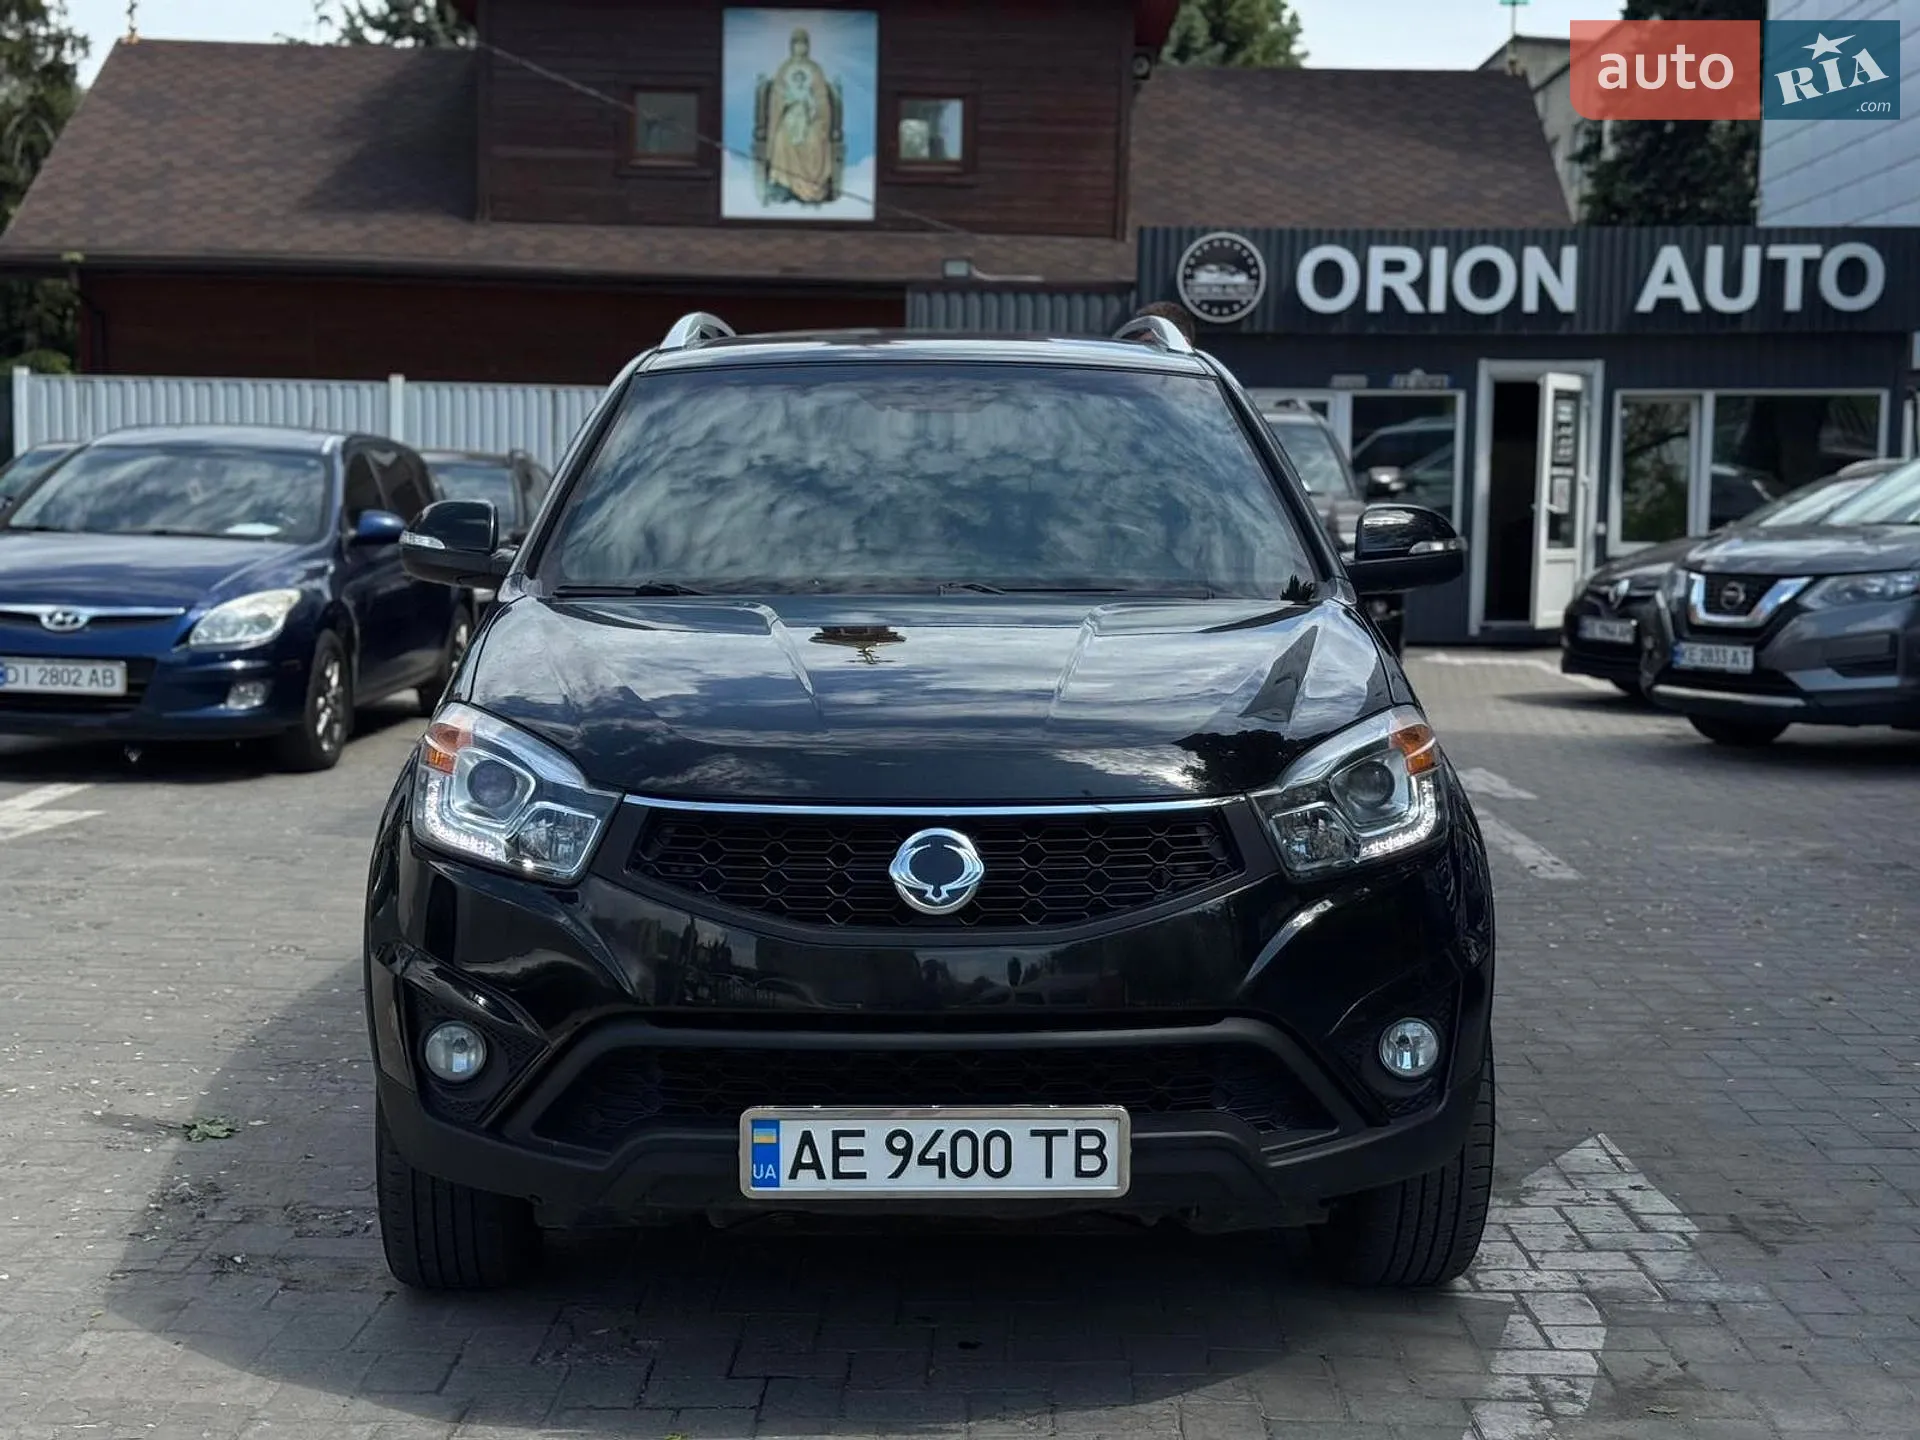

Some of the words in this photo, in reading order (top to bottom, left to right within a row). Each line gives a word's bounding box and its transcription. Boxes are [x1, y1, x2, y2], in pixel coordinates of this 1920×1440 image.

[1296, 244, 1578, 314] ORION
[1634, 242, 1885, 313] AUTO
[38, 666, 82, 687] 2802
[88, 668, 116, 688] AB
[752, 1163, 777, 1180] UA
[788, 1129, 867, 1180] AE
[885, 1128, 1012, 1179] 9400
[1029, 1128, 1108, 1180] TB
